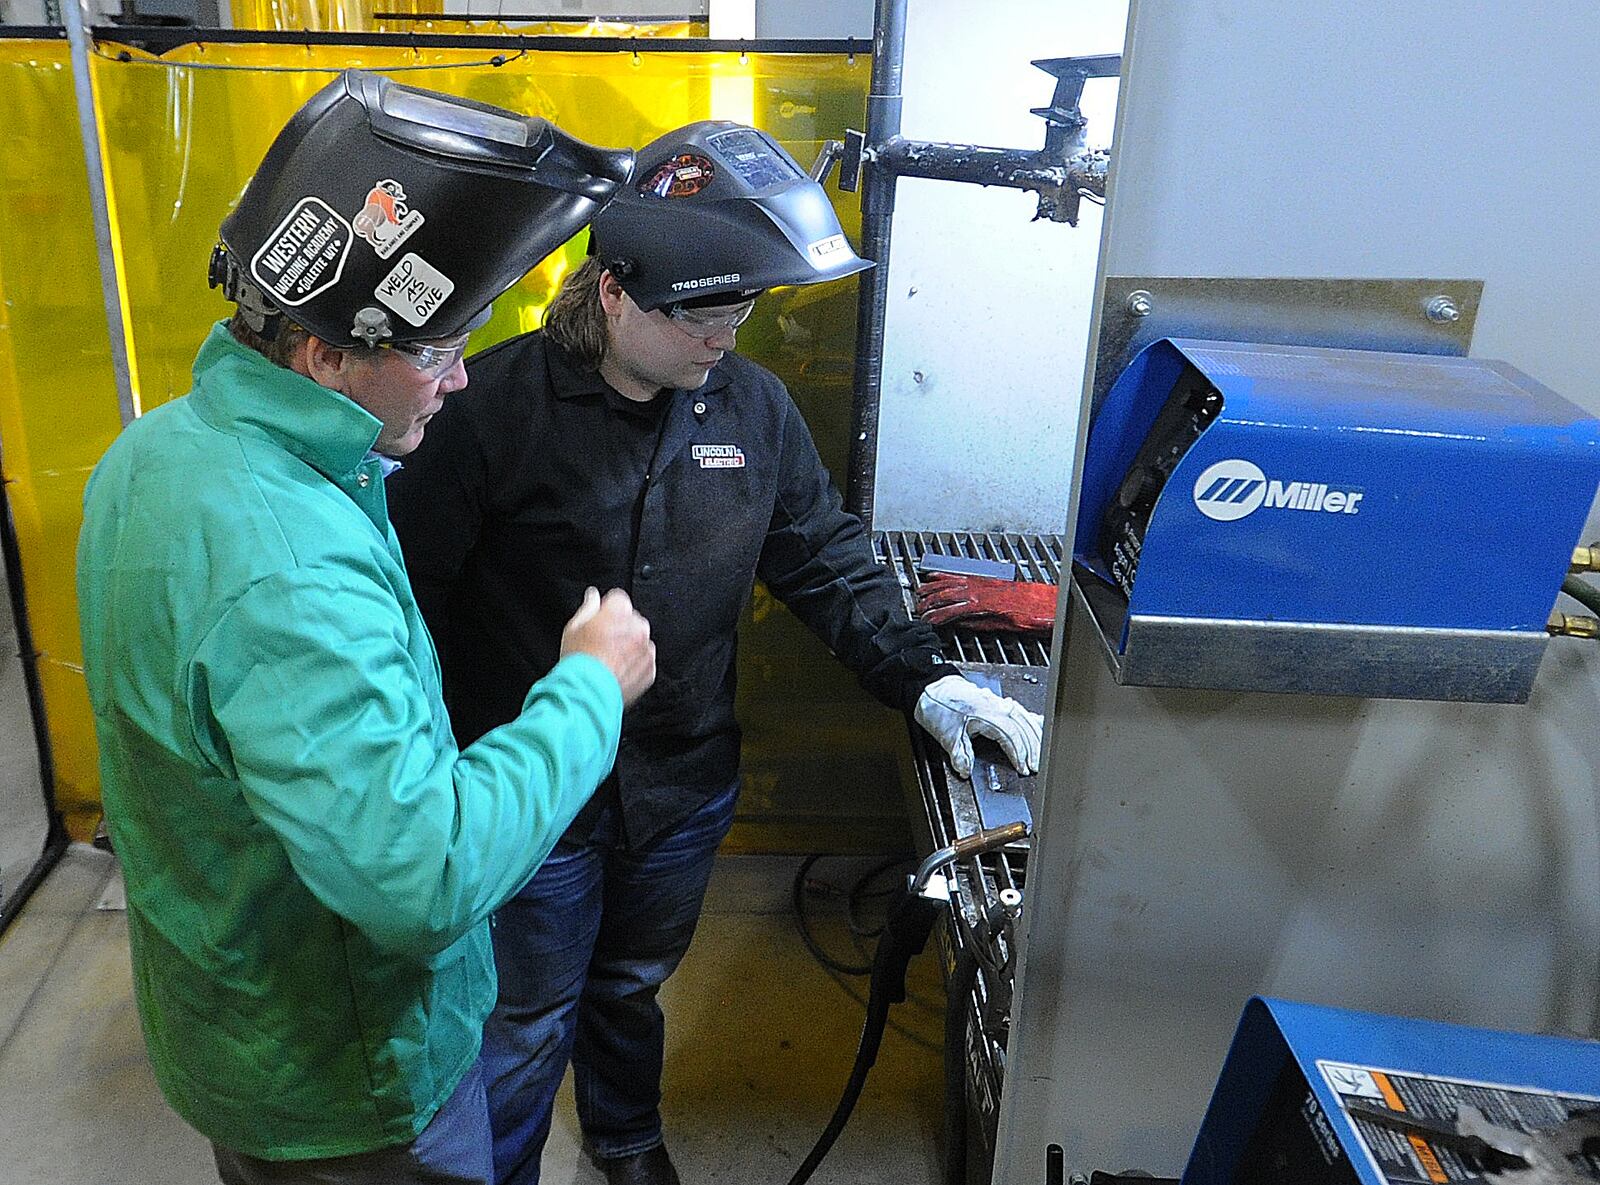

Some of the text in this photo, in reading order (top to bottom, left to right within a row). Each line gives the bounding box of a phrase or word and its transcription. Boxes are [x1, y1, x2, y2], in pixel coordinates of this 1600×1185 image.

[262, 208, 320, 274] WESTERN
[274, 217, 339, 295] WELDING ACADEMY
[299, 243, 339, 291] GILLETTE WY
[380, 260, 413, 296] WELD
[671, 273, 740, 292] 1740 SERIES
[407, 279, 424, 302] AS
[415, 288, 443, 317] ONE
[695, 447, 734, 457] LINCOLN
[1264, 480, 1364, 514] Miller
